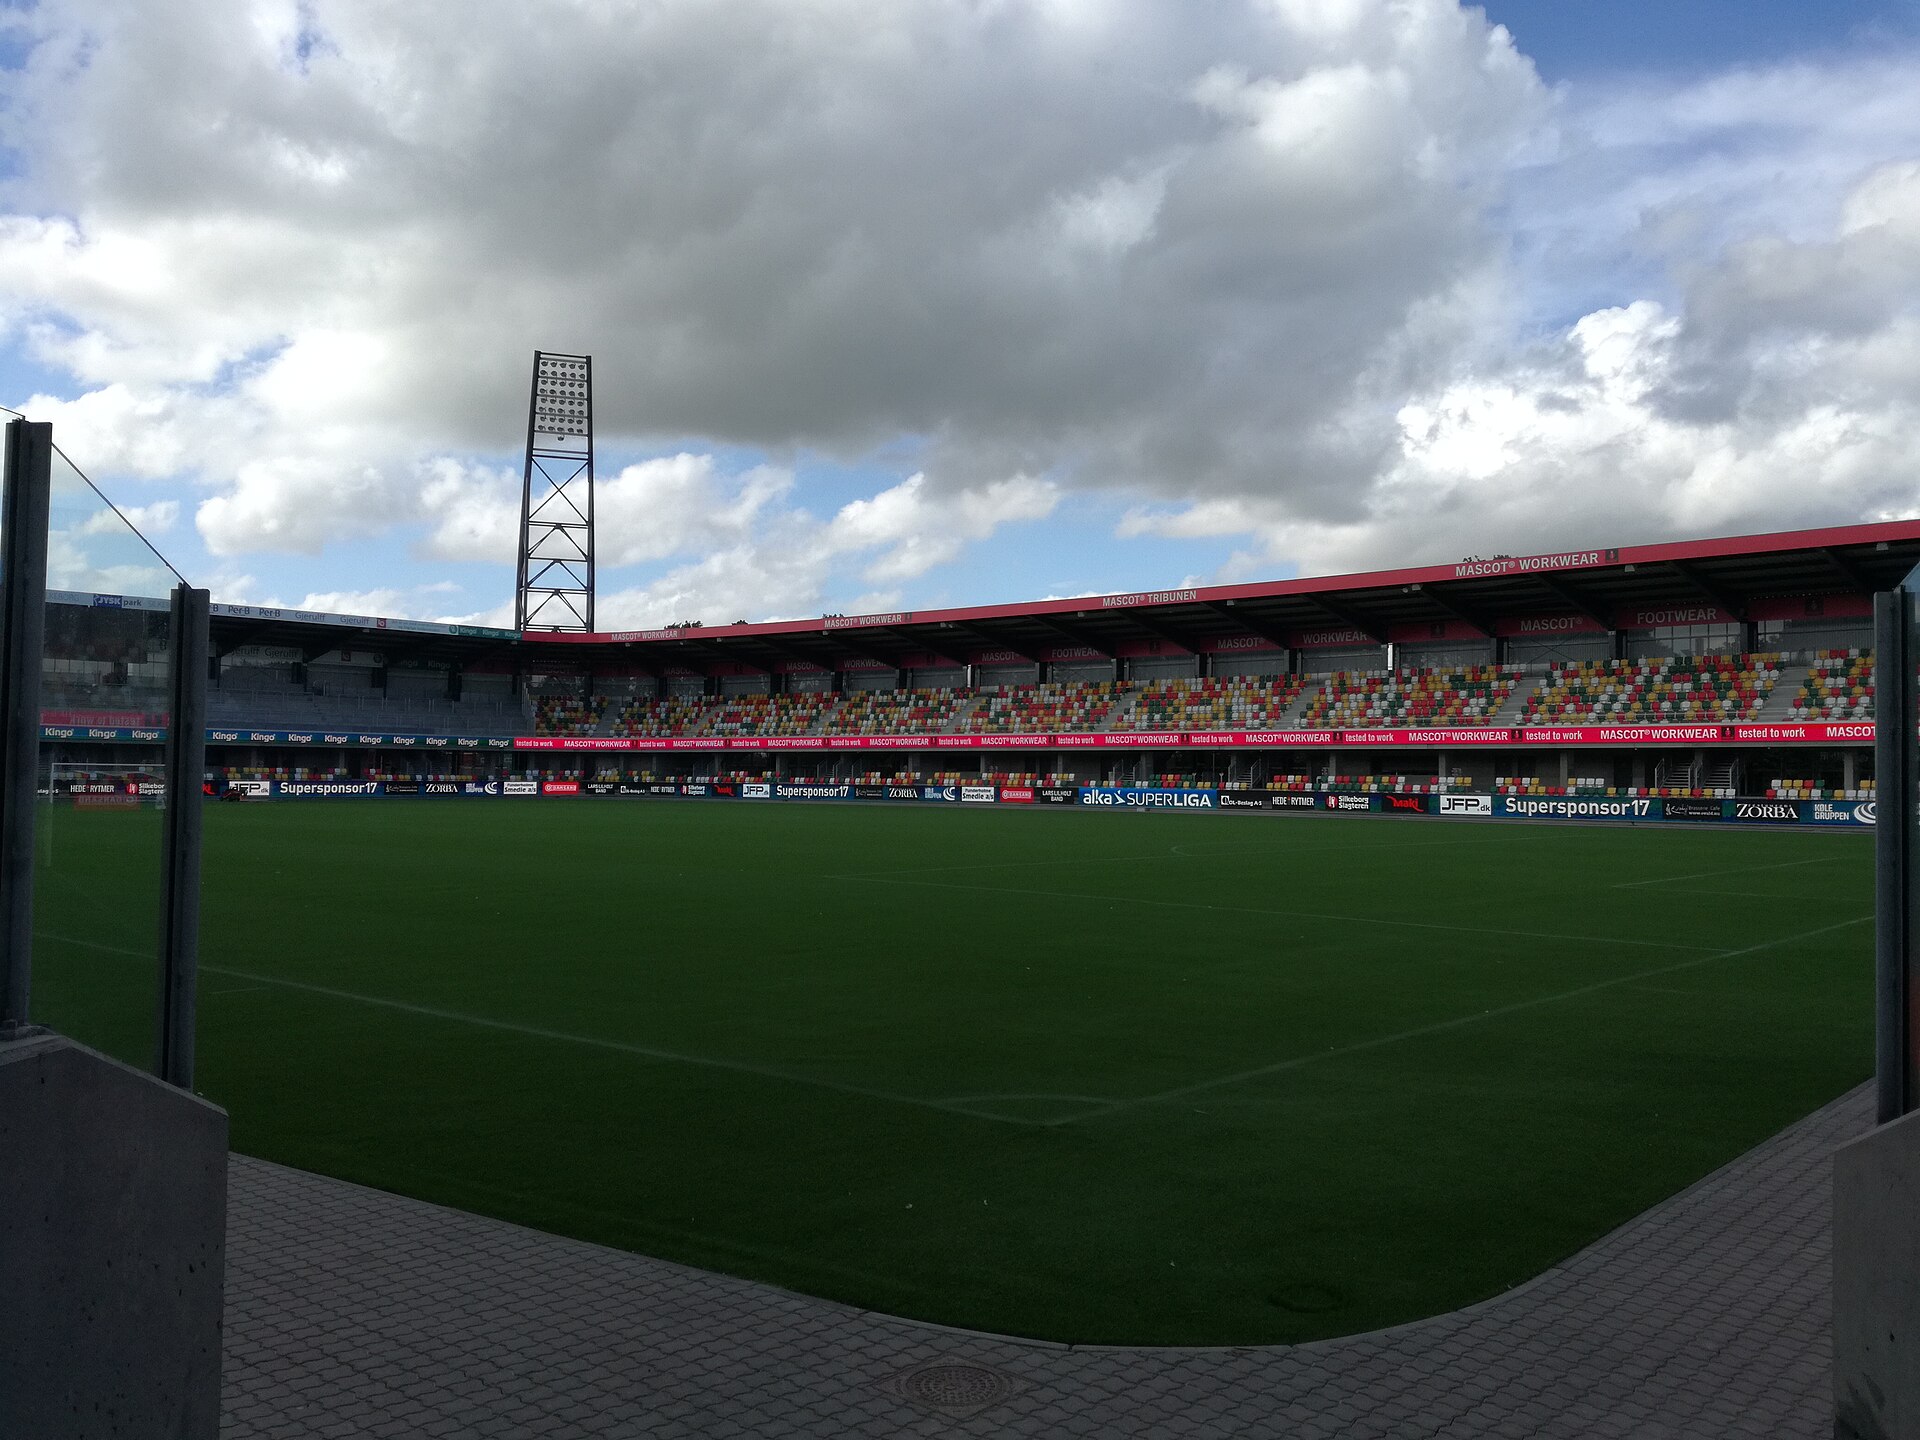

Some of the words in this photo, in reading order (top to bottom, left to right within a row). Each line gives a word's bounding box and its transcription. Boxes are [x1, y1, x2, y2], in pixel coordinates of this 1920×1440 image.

[1519, 553, 1598, 570] WORKWEAR
[1147, 590, 1197, 603] TRIBUNEN
[98, 596, 121, 606] JYSK
[124, 599, 142, 609] park
[859, 615, 902, 625] WORKWEAR
[1637, 608, 1717, 624] FOOTWEAR
[642, 631, 678, 640] WORKWEAR
[1345, 733, 1367, 742] tested
[1368, 733, 1375, 742] to
[1377, 733, 1394, 741] work
[1452, 731, 1508, 741] WORKWEAR
[1526, 731, 1550, 740] tested
[1552, 731, 1560, 740] to
[1563, 731, 1583, 740] work
[1651, 728, 1718, 739] WORKWEAR
[1739, 728, 1767, 738] tested
[1770, 728, 1779, 738] to
[1782, 727, 1805, 738] work
[896, 738, 929, 746] WORKWEAR
[1010, 736, 1047, 744] WORKWEAR
[1192, 735, 1210, 743] tested
[1211, 735, 1217, 743] to
[1282, 734, 1330, 742] WORKWEAR
[70, 785, 86, 793] HEDE
[90, 785, 114, 793] RYTMER
[280, 782, 378, 796] Supersponsor17
[426, 783, 458, 793] ZORBA
[776, 785, 849, 798] Supersponsor17
[889, 788, 918, 798] ZORBA
[1126, 793, 1212, 807] SUPERLIGA
[1272, 796, 1287, 805] HEDE
[1290, 796, 1314, 806] RYTMER
[1338, 795, 1369, 803] Silkeborg
[1338, 802, 1369, 810] Slagteren
[1505, 797, 1650, 818] Supersponsor17
[1814, 804, 1833, 812] KØLE
[1736, 804, 1799, 819] ZORBA
[1814, 812, 1850, 821] GRUPPEN
